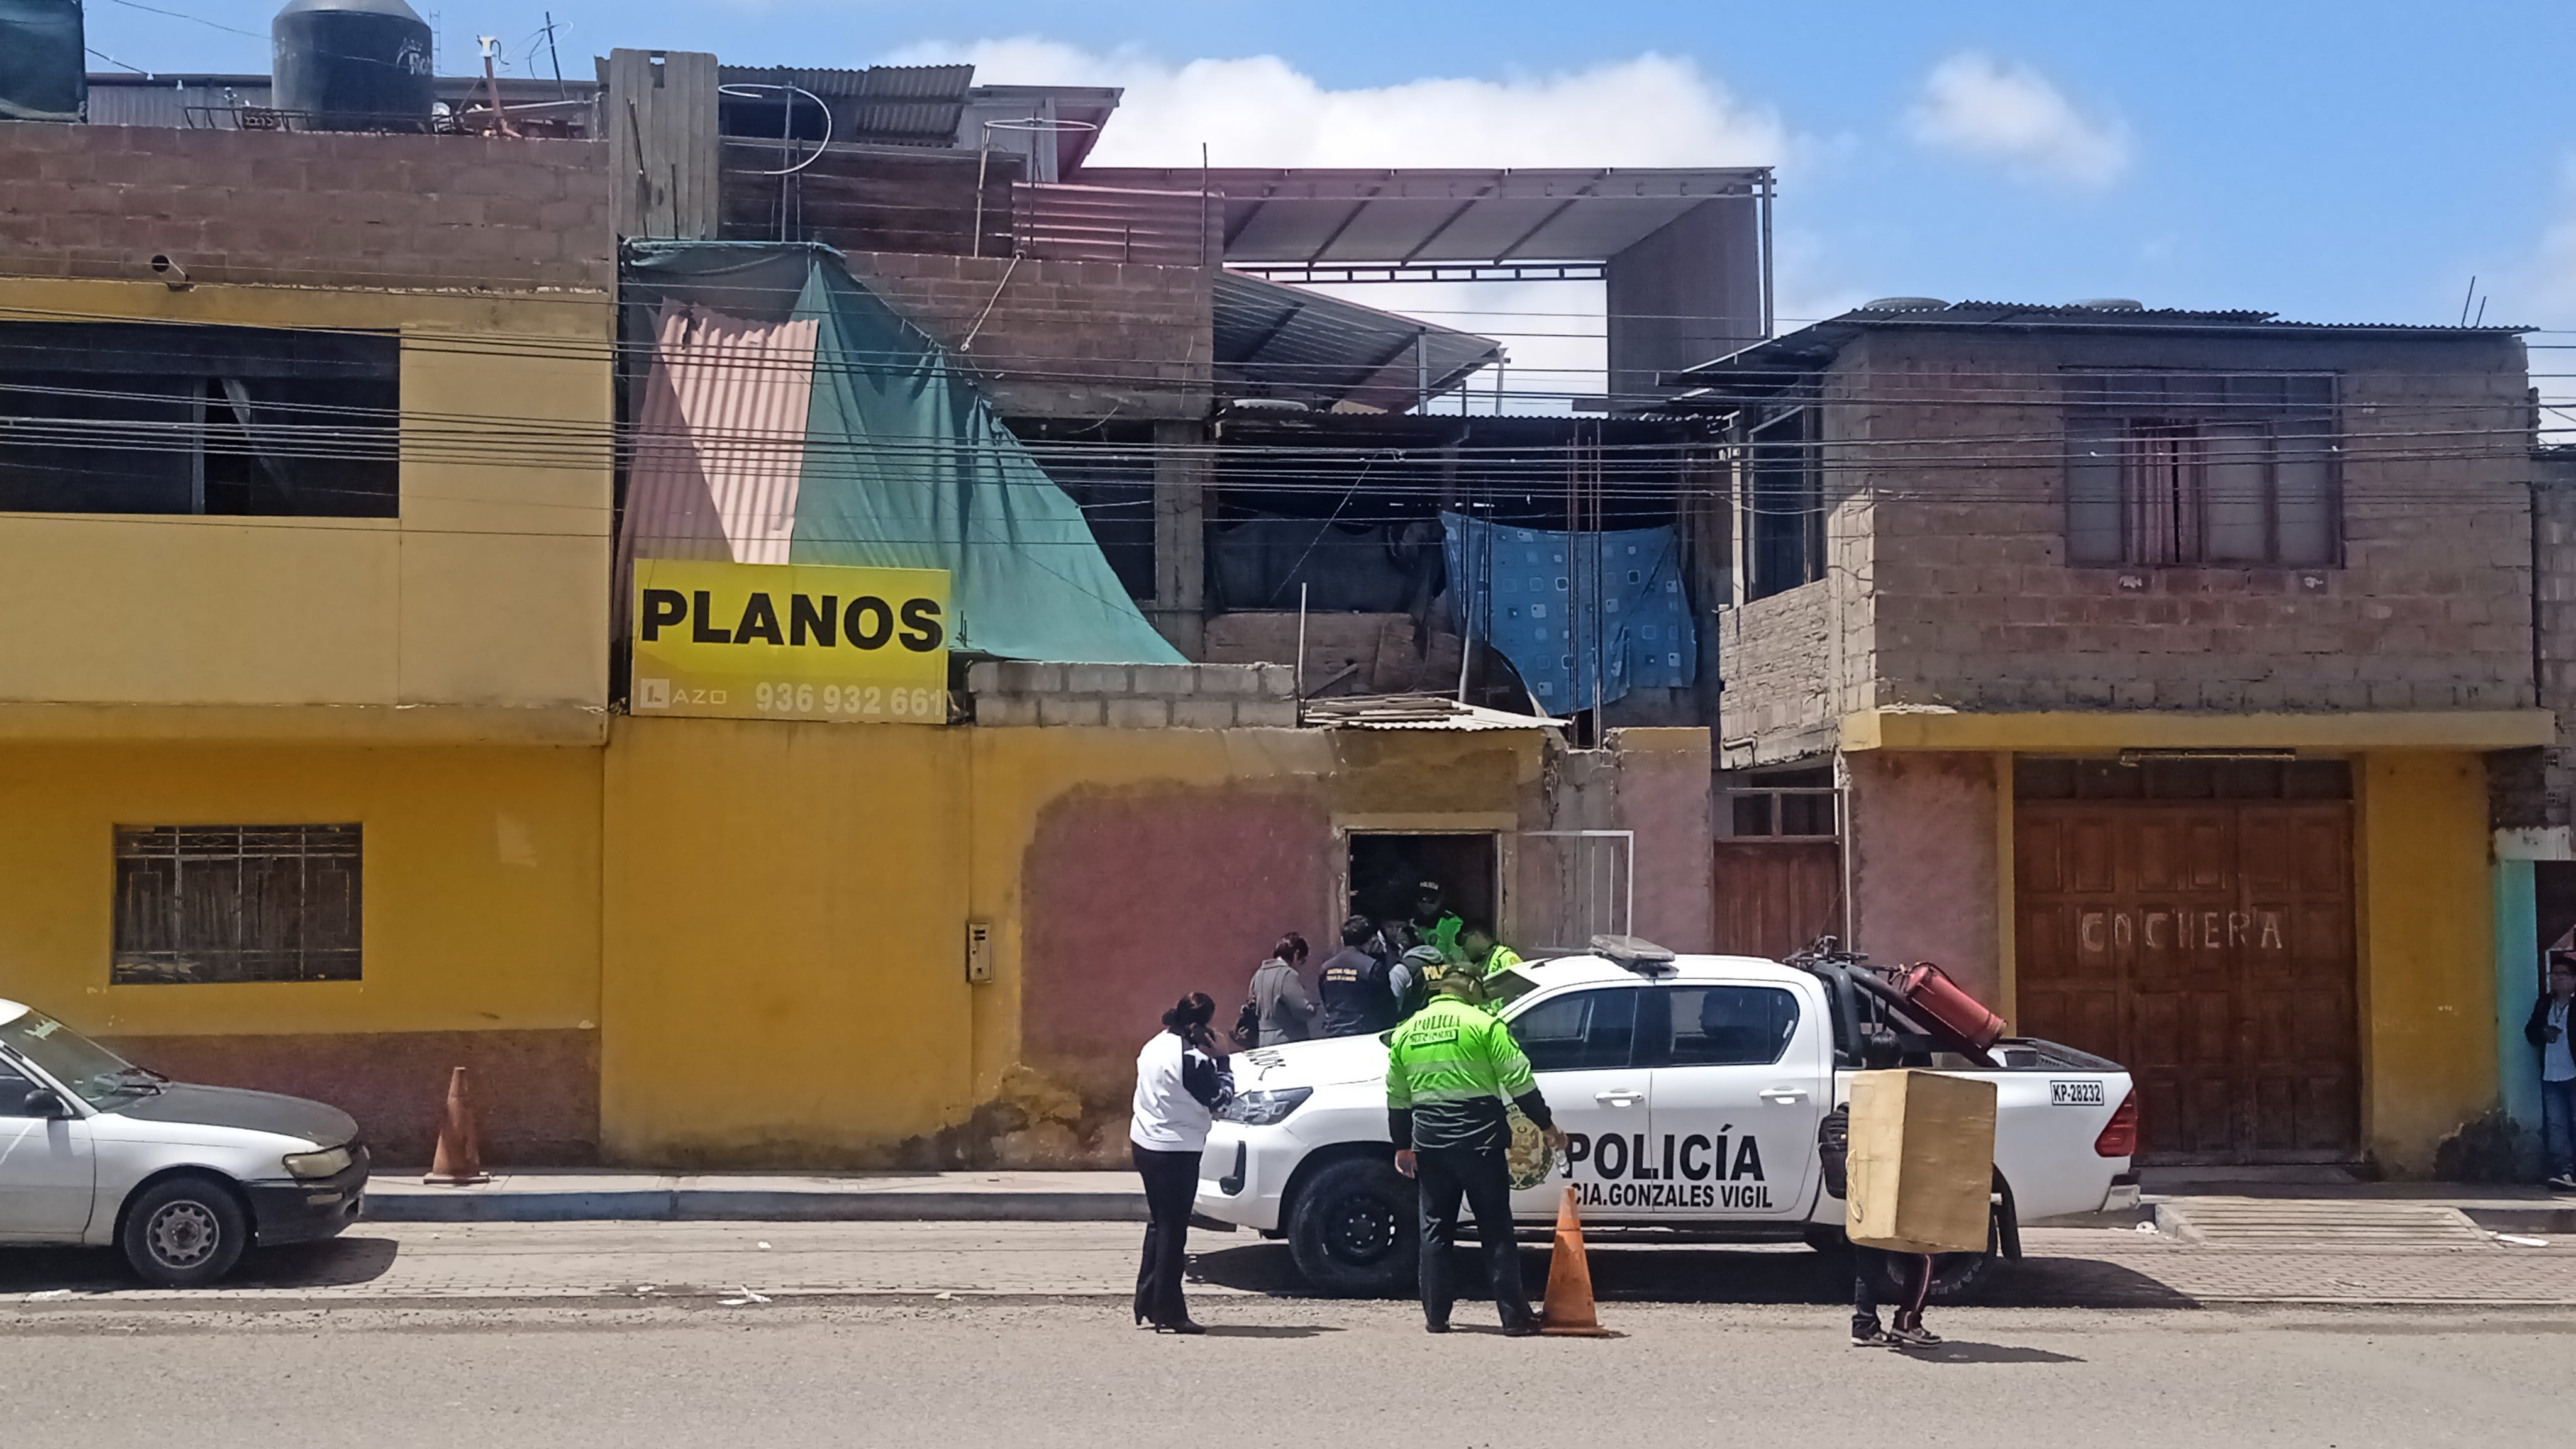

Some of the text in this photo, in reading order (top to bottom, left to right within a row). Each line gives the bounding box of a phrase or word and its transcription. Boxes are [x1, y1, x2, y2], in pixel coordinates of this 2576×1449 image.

[641, 589, 944, 652] PLANOS
[642, 680, 727, 706] LAZO
[756, 682, 941, 716] 936 932 661
[2082, 911, 2283, 952] COCHERA
[2053, 1084, 2101, 1102] KP-28232
[1562, 1124, 1765, 1181] POLICÍA
[1721, 1185, 1773, 1208] VIGIL
